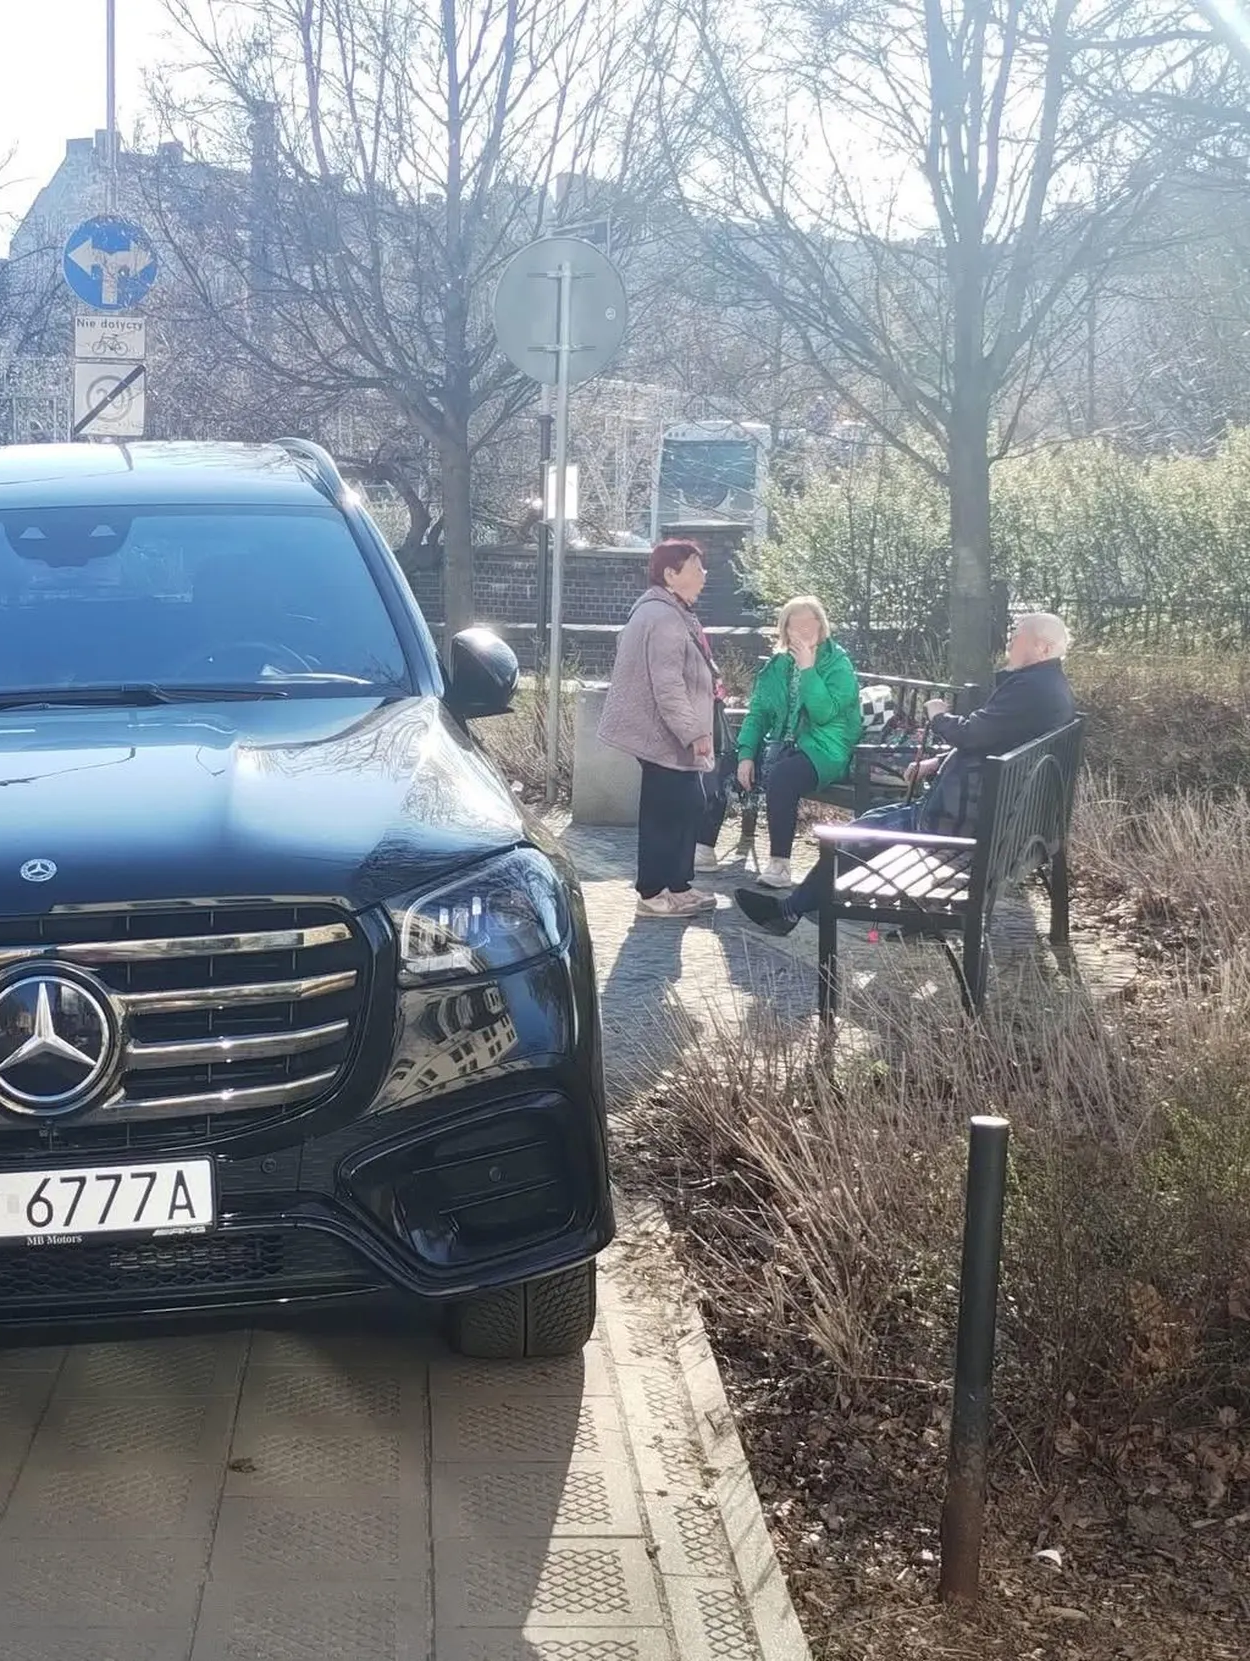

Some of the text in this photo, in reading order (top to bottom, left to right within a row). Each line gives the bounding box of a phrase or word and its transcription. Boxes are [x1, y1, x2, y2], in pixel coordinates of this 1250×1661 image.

[76, 317, 143, 332] Nie dotyczy
[26, 1170, 196, 1229] 6777A
[26, 1234, 83, 1246] MB Motors
